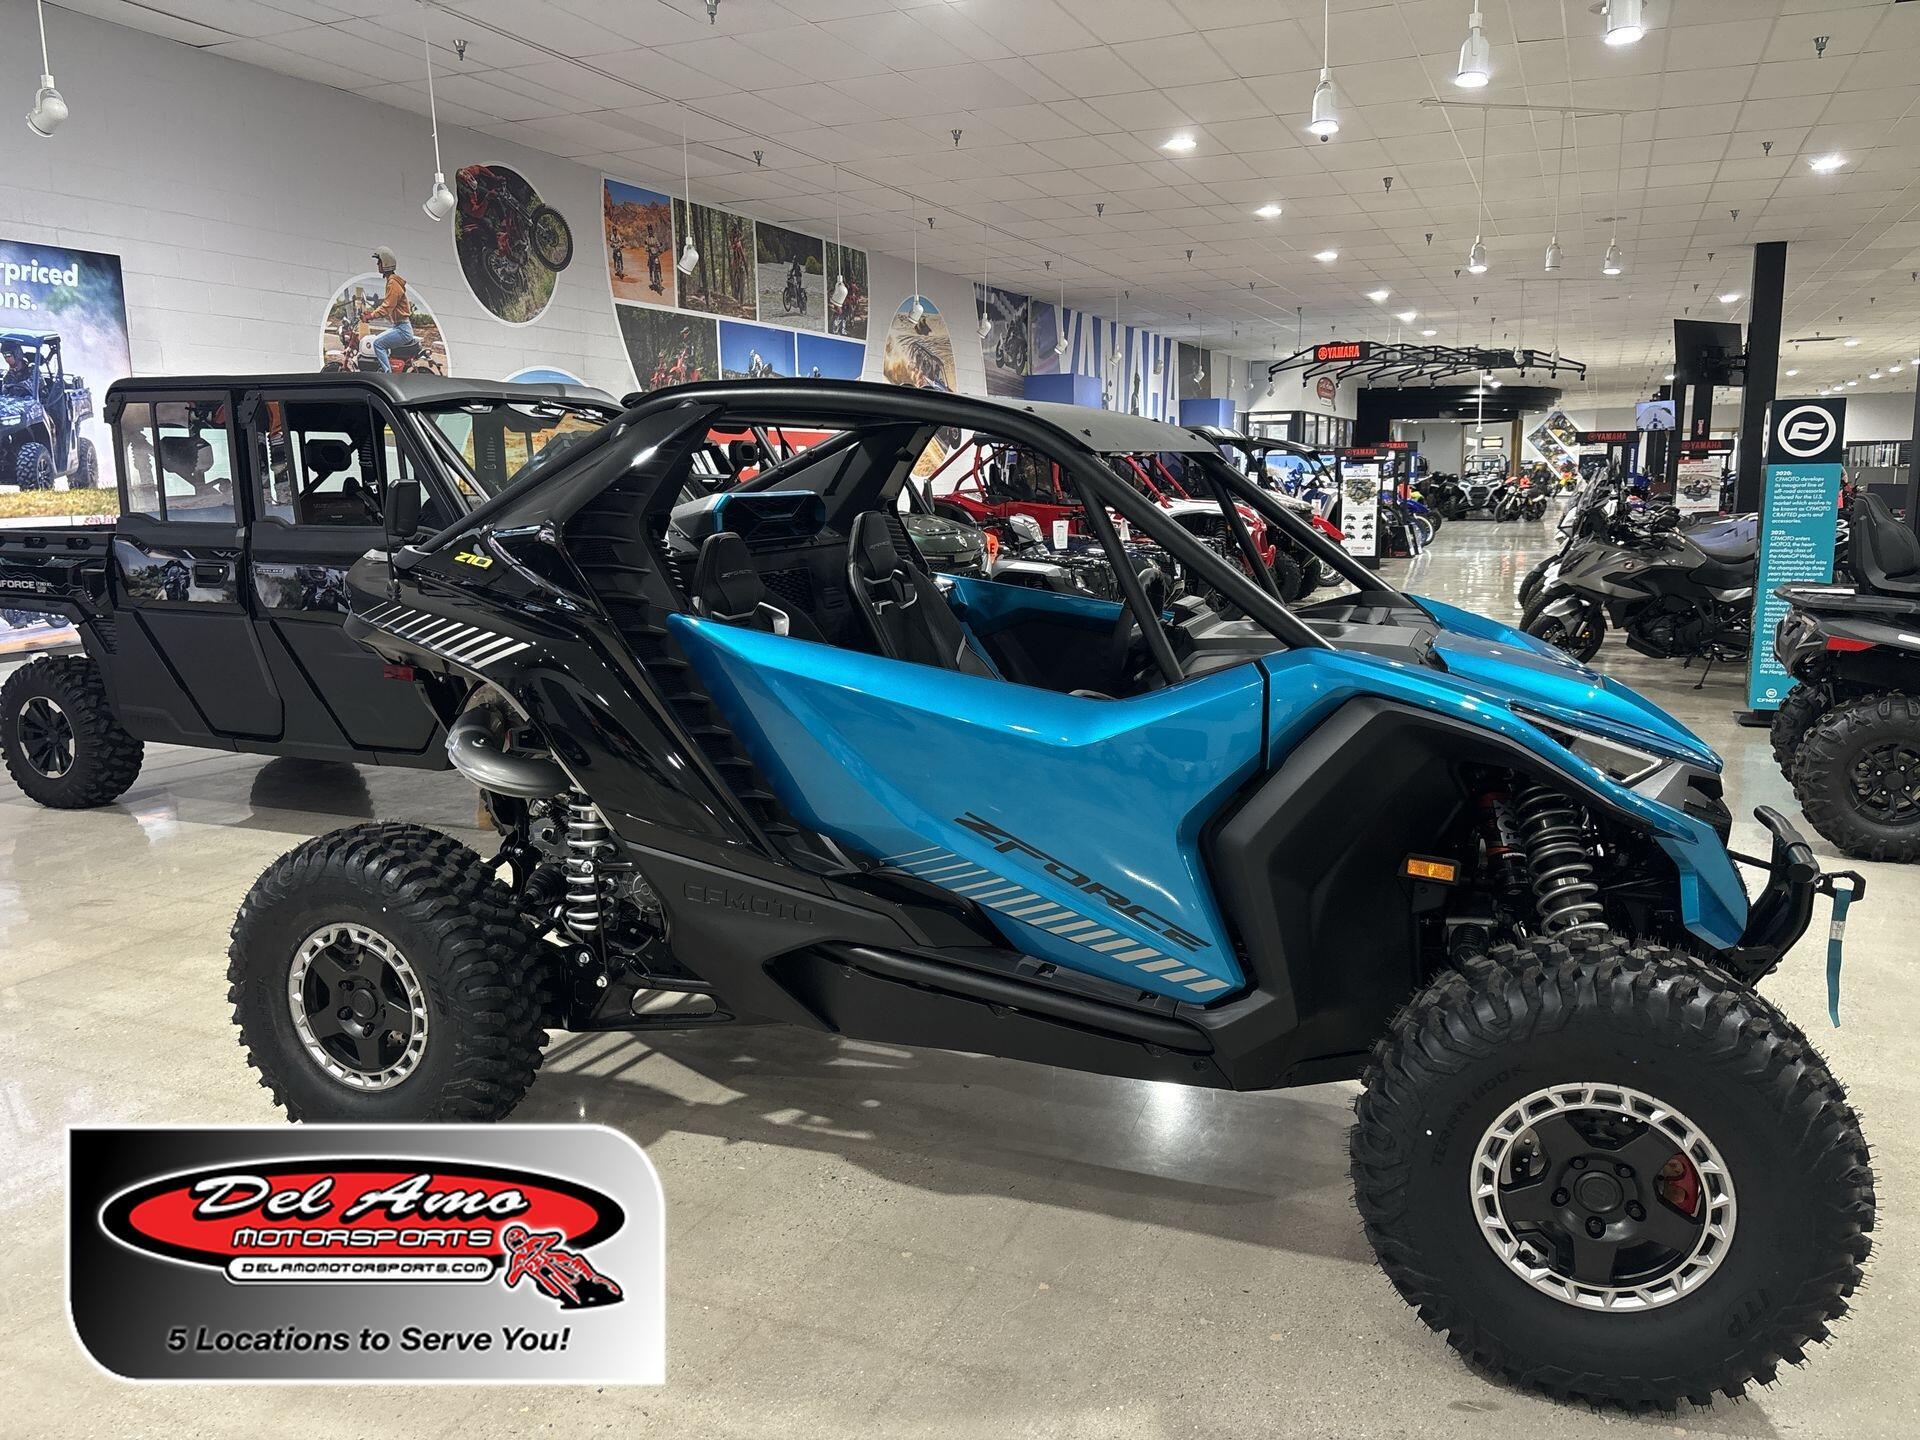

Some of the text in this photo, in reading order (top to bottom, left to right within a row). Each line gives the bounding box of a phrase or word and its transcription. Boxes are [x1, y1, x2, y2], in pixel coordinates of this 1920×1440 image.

[1328, 345, 1359, 359] YAMAHA
[1597, 432, 1627, 441] YAMAHA
[1690, 441, 1722, 449] YAMAHA
[454, 551, 494, 568] Z10
[0, 580, 35, 589] FORCE
[953, 811, 1212, 953] ZFORCE
[683, 880, 816, 925] CFMOTO
